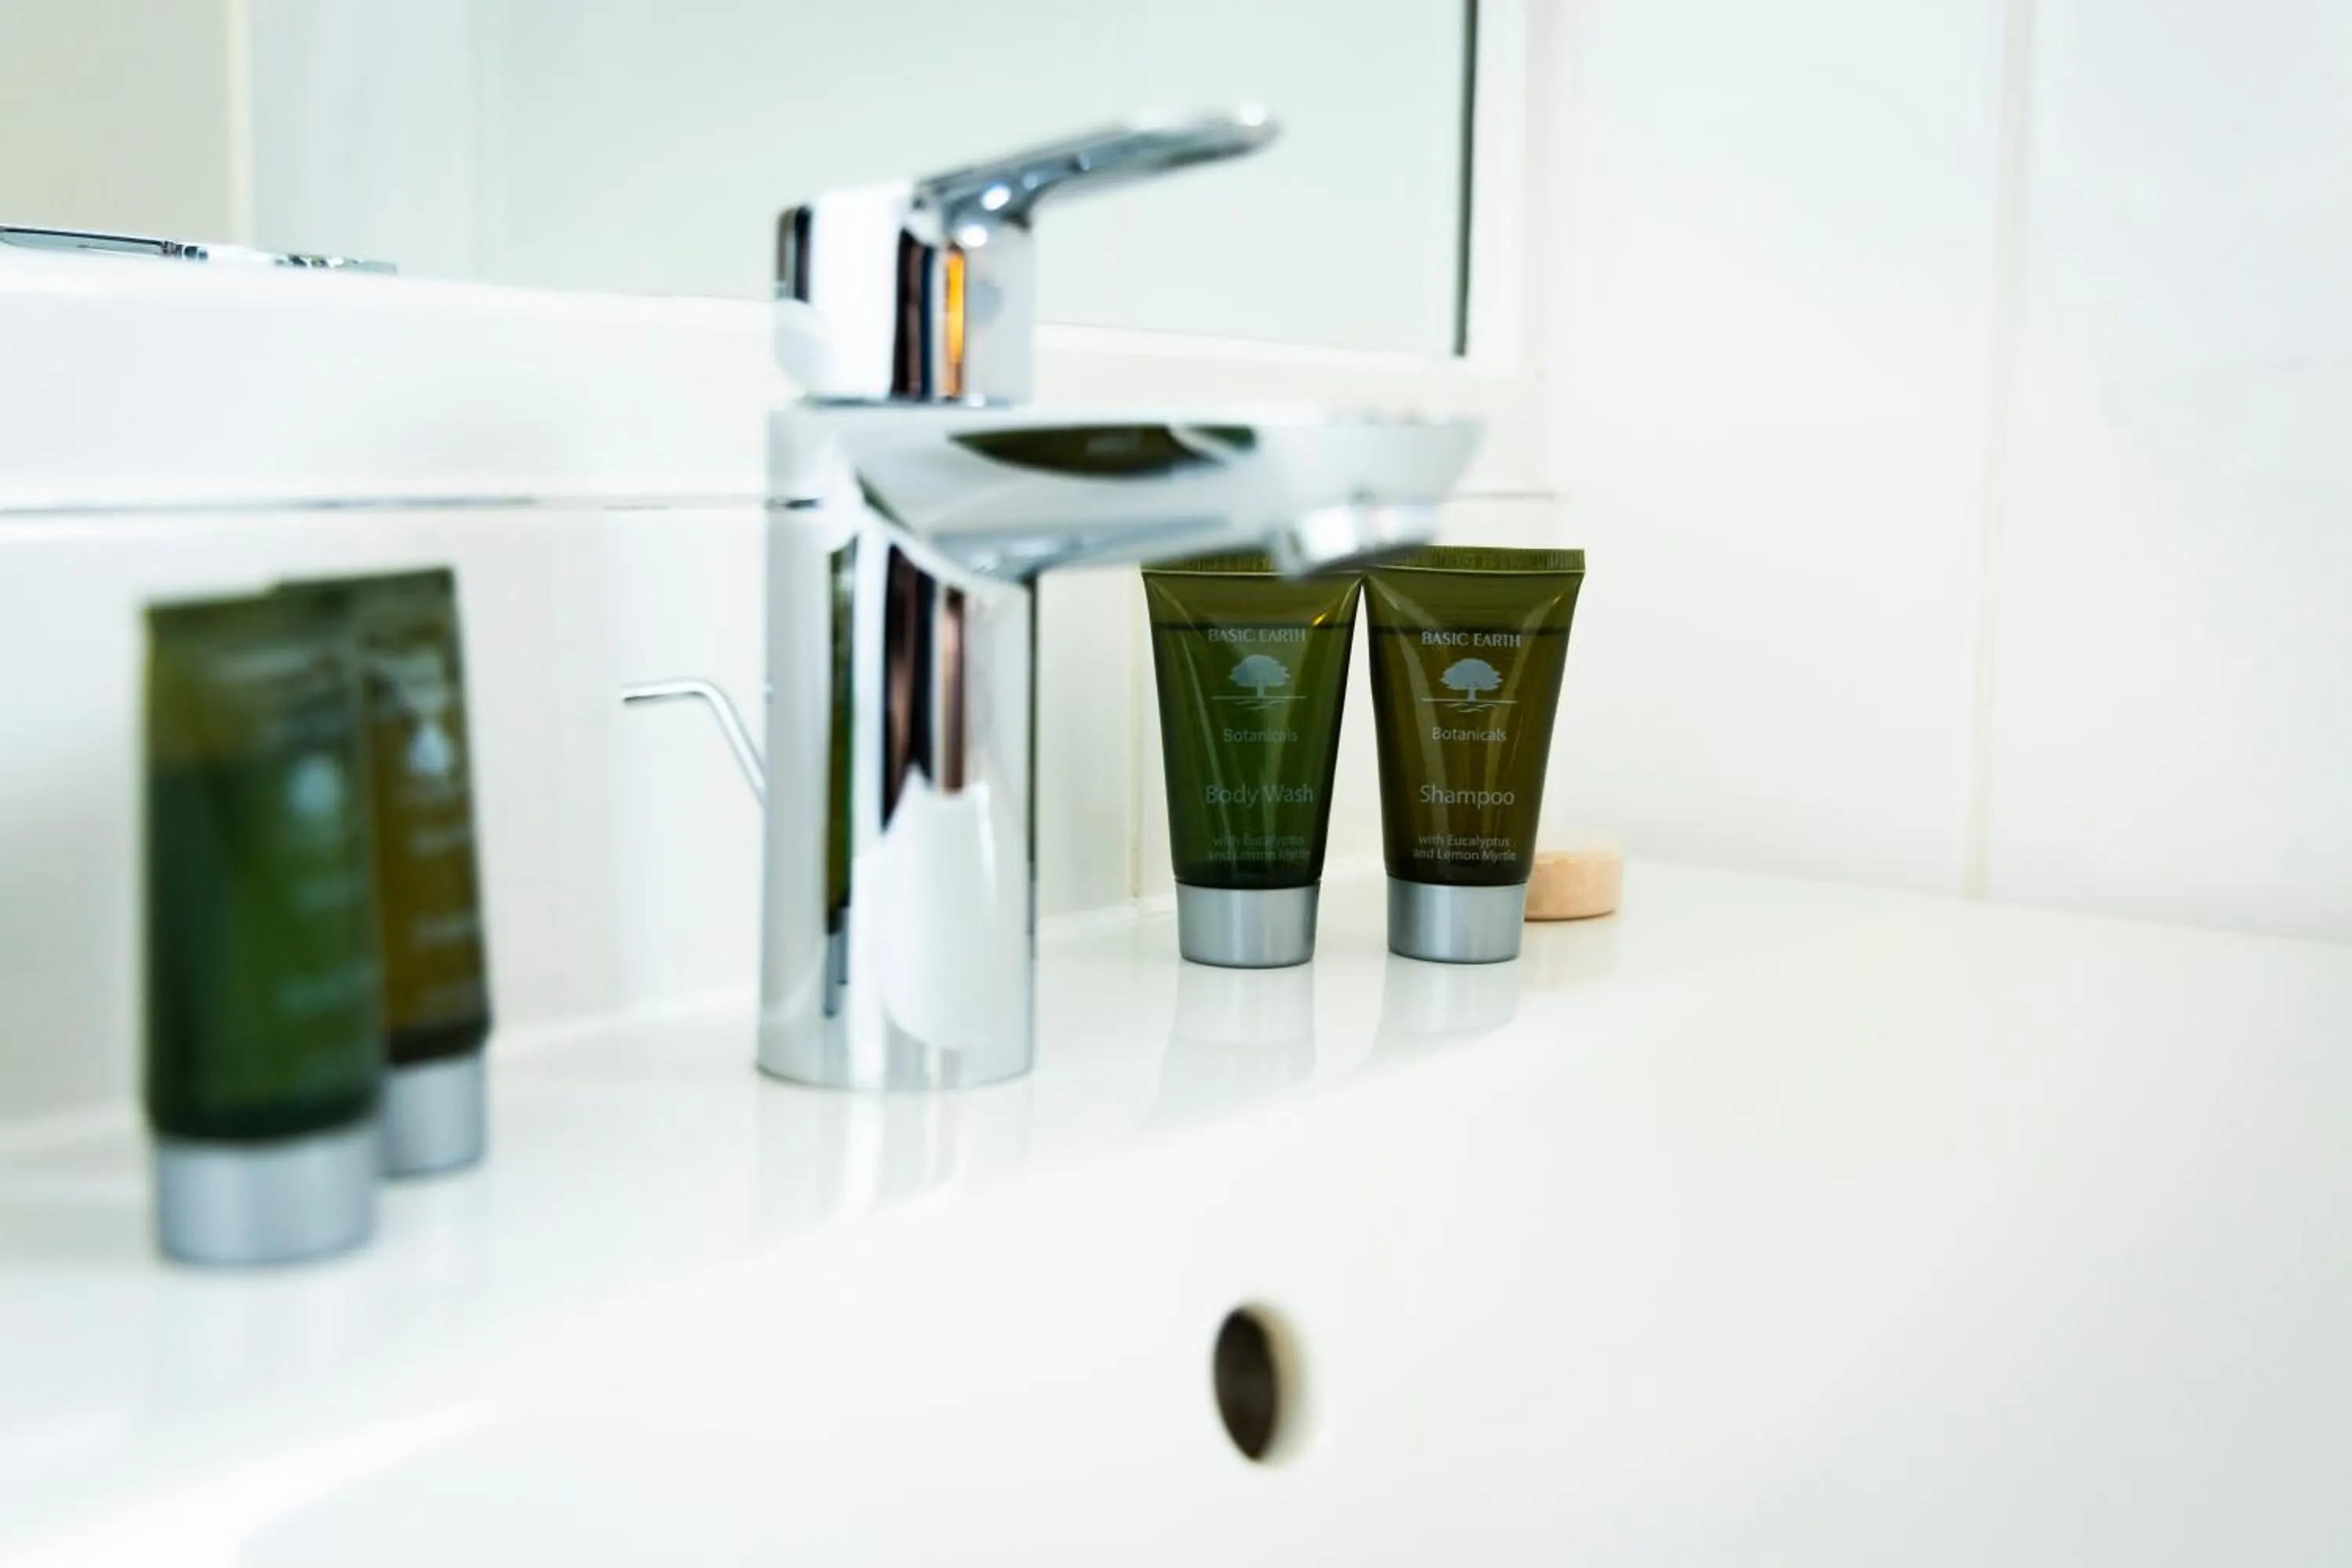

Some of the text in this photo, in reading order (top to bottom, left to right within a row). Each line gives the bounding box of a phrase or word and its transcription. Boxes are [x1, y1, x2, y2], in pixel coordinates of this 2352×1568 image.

[1208, 628, 1305, 643] BASIC EARTH
[1421, 630, 1521, 648] BASIC EARTH
[1223, 728, 1298, 743] Botanicals
[1432, 726, 1506, 742] Botanicals
[1206, 783, 1313, 808] Body Wash
[1419, 783, 1515, 809] Shampoo
[1418, 833, 1512, 850] with Eucalyptus
[1413, 848, 1516, 865] and Lemon Myrtle
